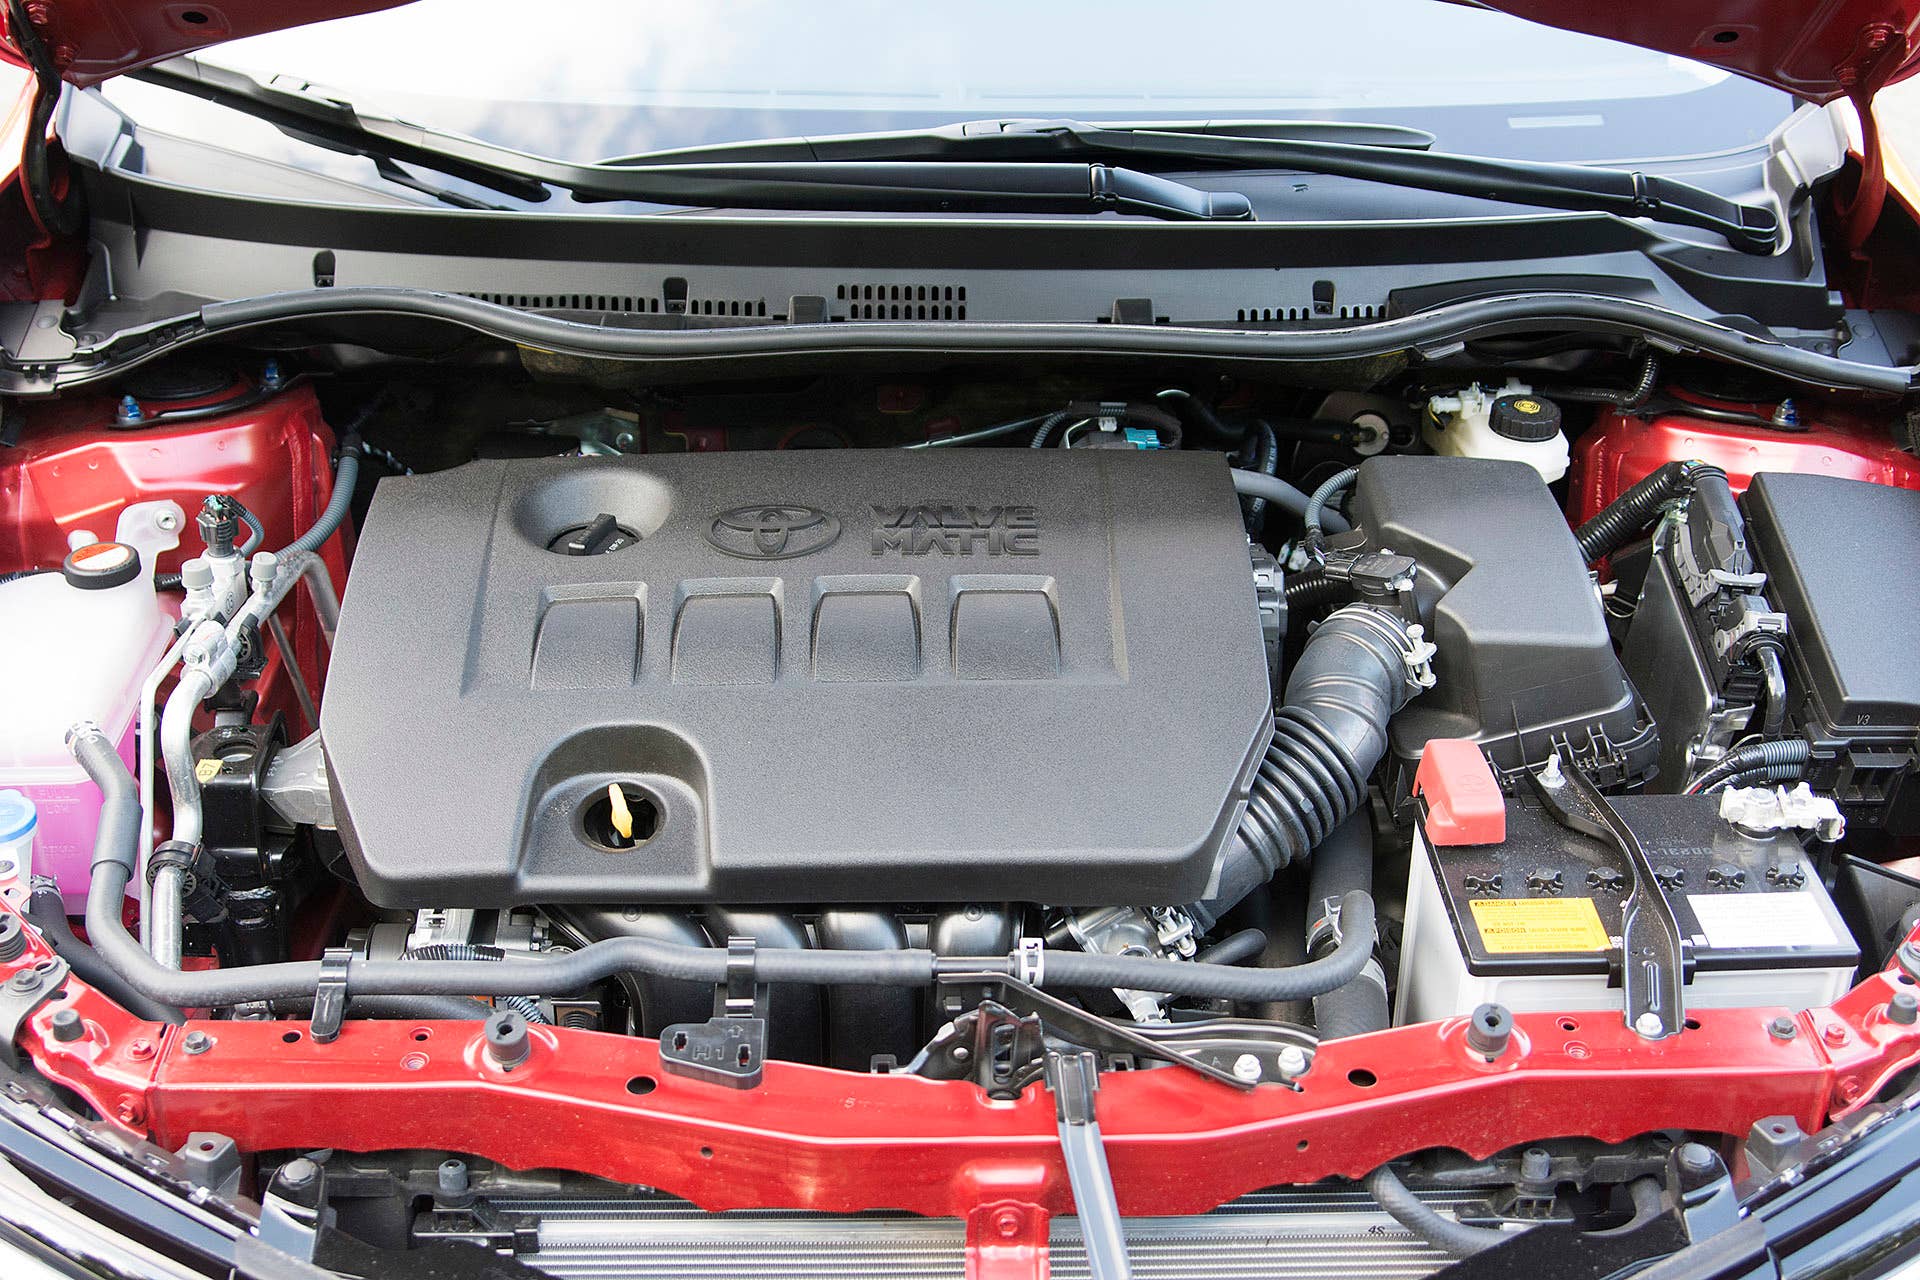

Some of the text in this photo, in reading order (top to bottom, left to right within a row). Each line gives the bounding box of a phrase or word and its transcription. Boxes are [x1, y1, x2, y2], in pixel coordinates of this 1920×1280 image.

[869, 505, 1038, 529] VALVE
[871, 529, 1040, 556] MATIC
[1856, 714, 1871, 726] V3
[692, 1044, 725, 1060] H1
